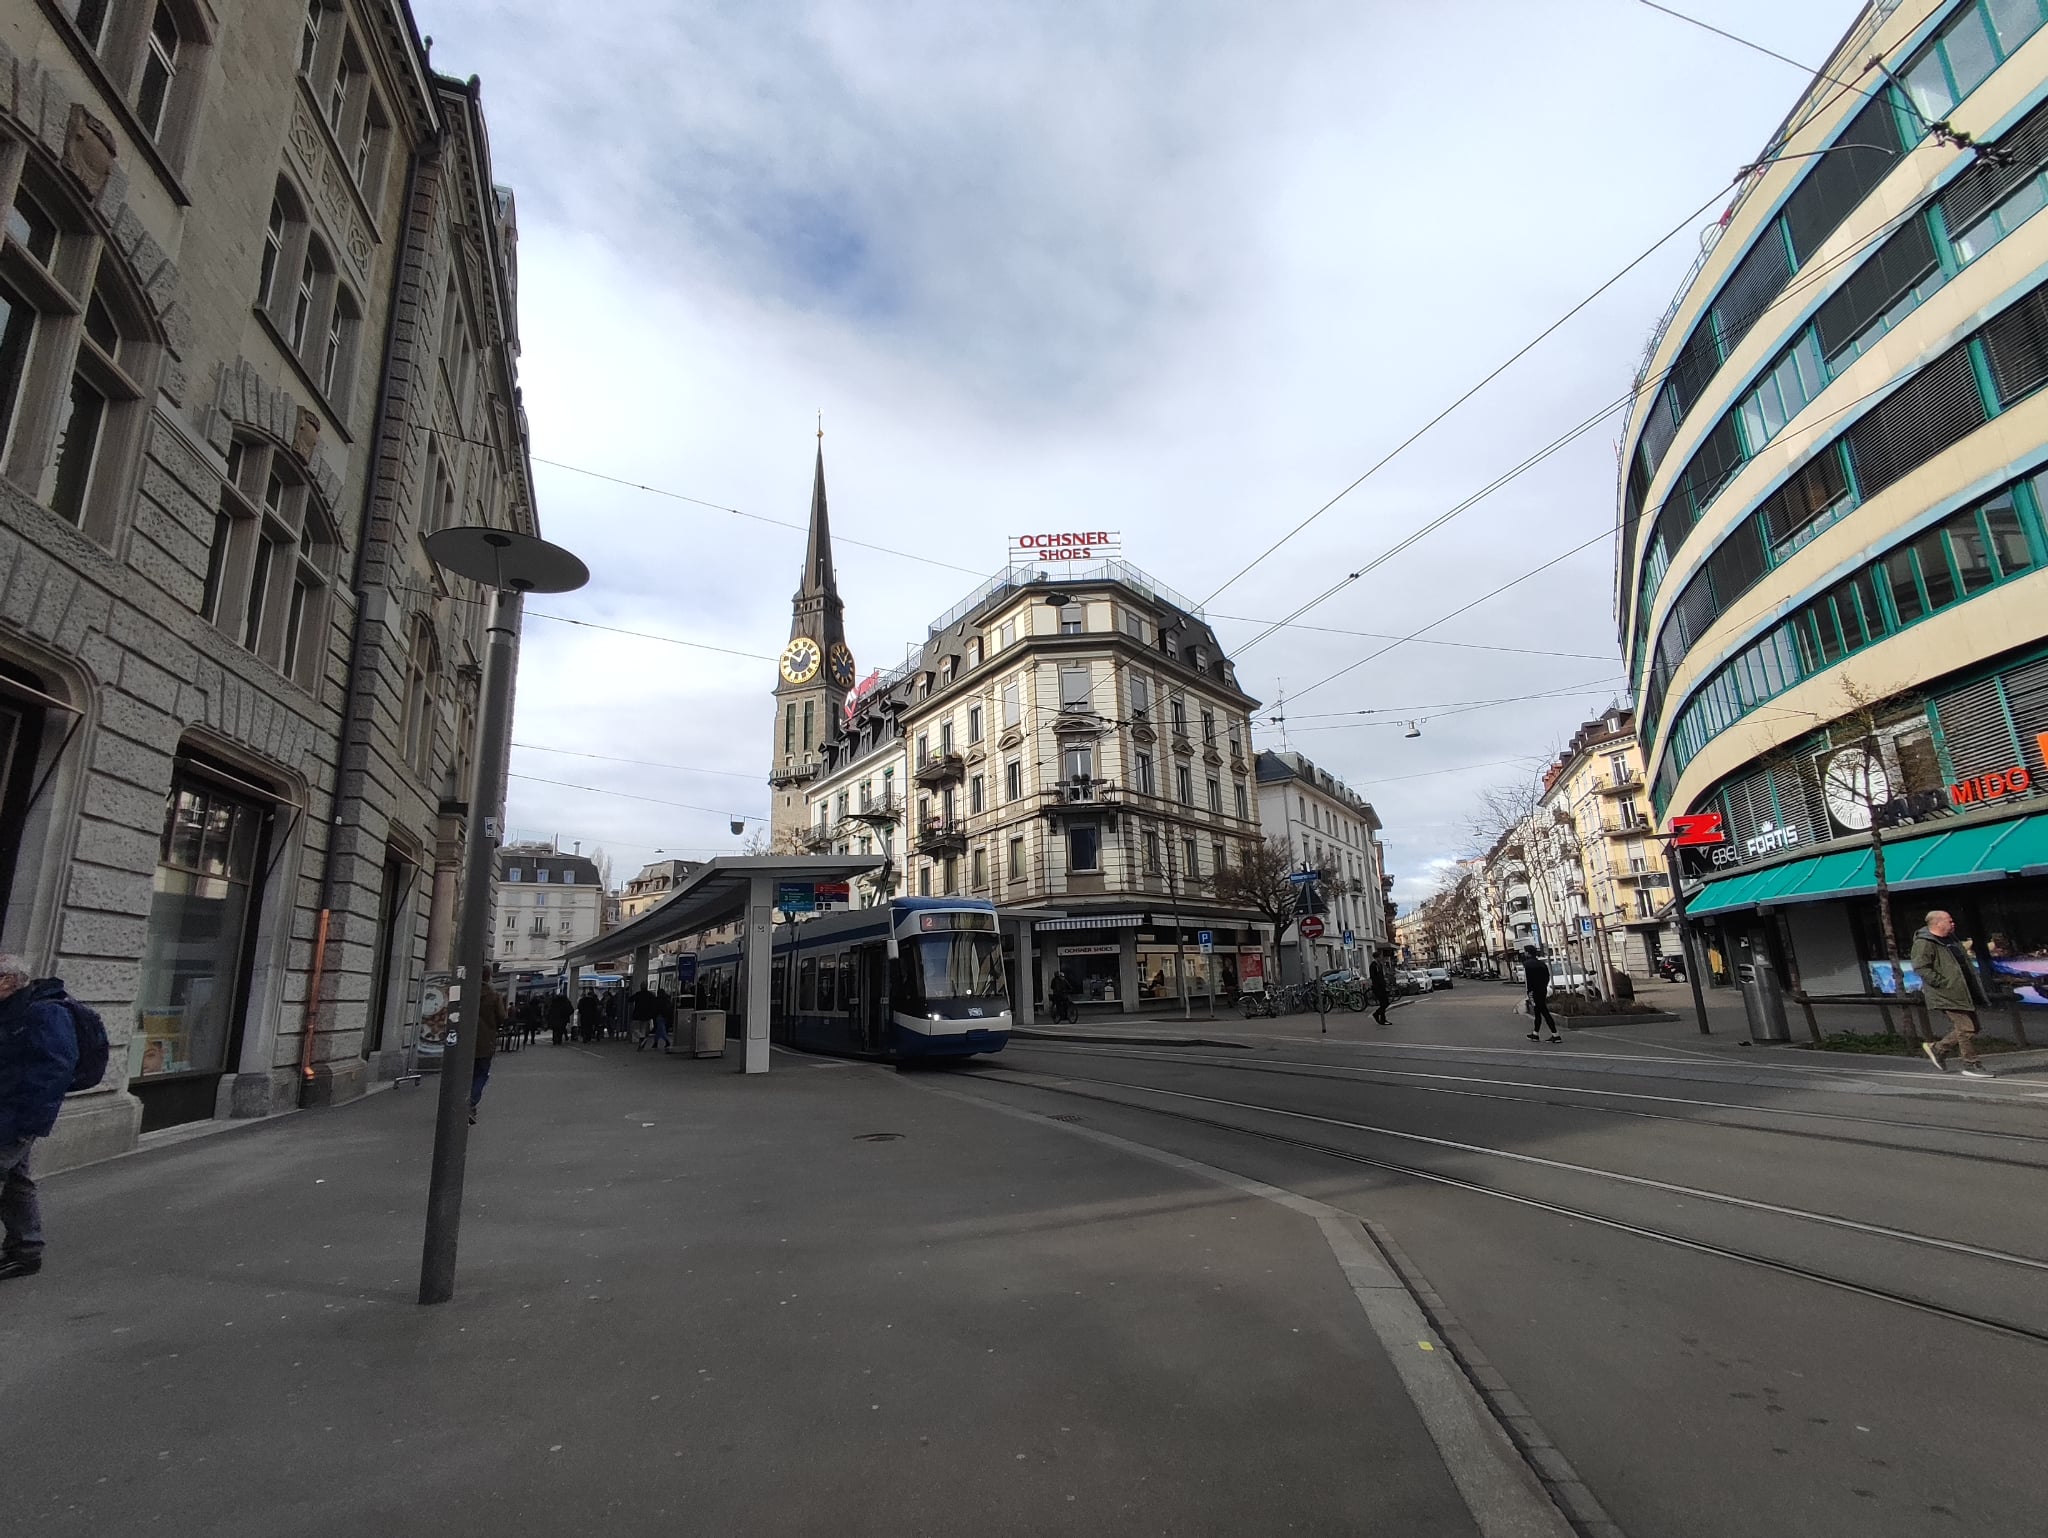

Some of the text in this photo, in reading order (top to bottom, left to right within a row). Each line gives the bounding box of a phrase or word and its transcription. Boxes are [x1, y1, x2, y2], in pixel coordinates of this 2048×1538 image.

[1019, 531, 1110, 549] OCHSNER
[1039, 548, 1091, 561] SHOES
[1950, 766, 2032, 805] MIDO
[1747, 825, 1799, 856] FORTIS
[925, 917, 933, 927] 2
[1202, 933, 1208, 943] P
